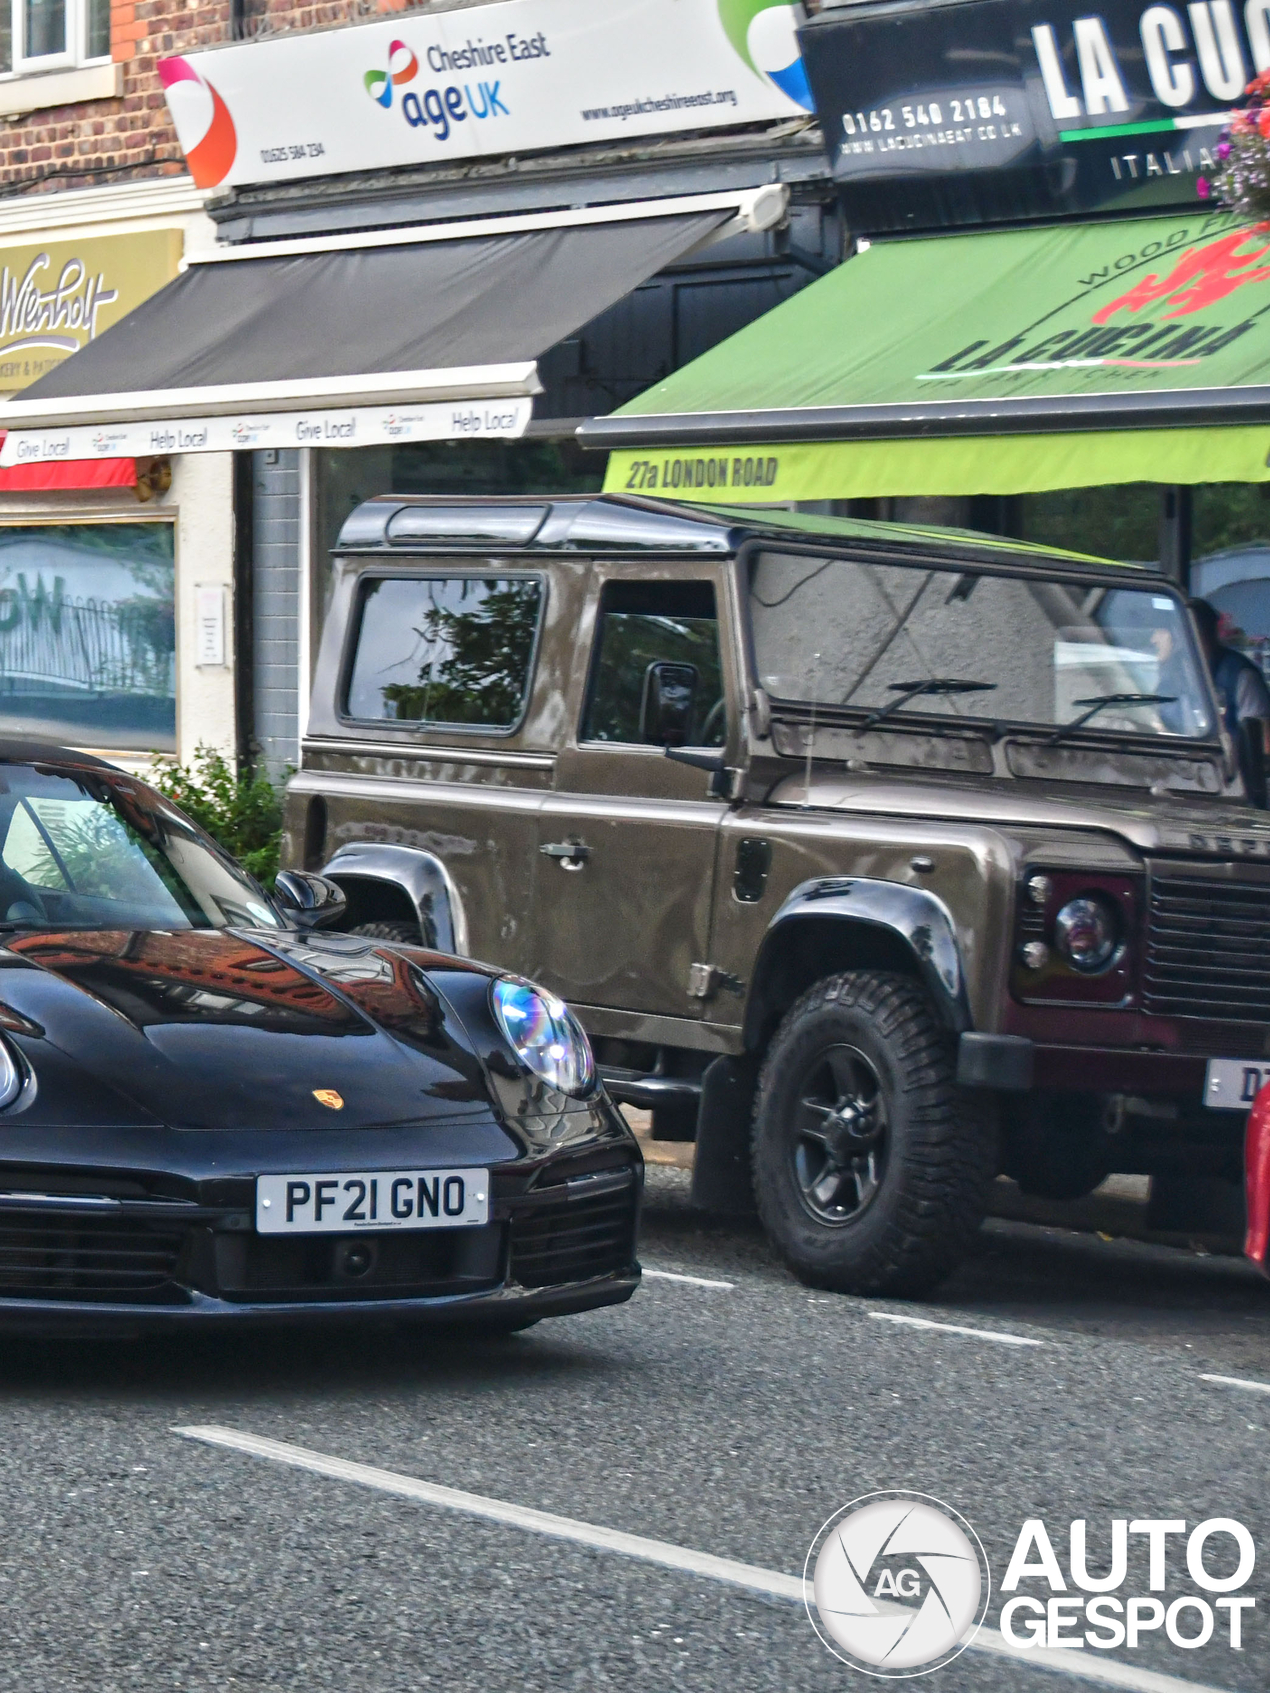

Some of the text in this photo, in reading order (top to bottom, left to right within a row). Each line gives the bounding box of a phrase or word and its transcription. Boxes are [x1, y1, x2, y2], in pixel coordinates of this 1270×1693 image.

[427, 31, 551, 72] Cheshire East
[1031, 17, 1129, 119] LA
[842, 108, 896, 135] 0162
[1077, 229, 1188, 286] WOOD
[930, 320, 1259, 372] LA CUCINA
[296, 417, 356, 440] Give Local
[452, 407, 519, 433] Help Local
[16, 437, 70, 458] Give Local
[150, 428, 208, 453] Help Local
[626, 457, 779, 488] 27a LONDON ROAD
[286, 1175, 465, 1222] PF21 GNO
